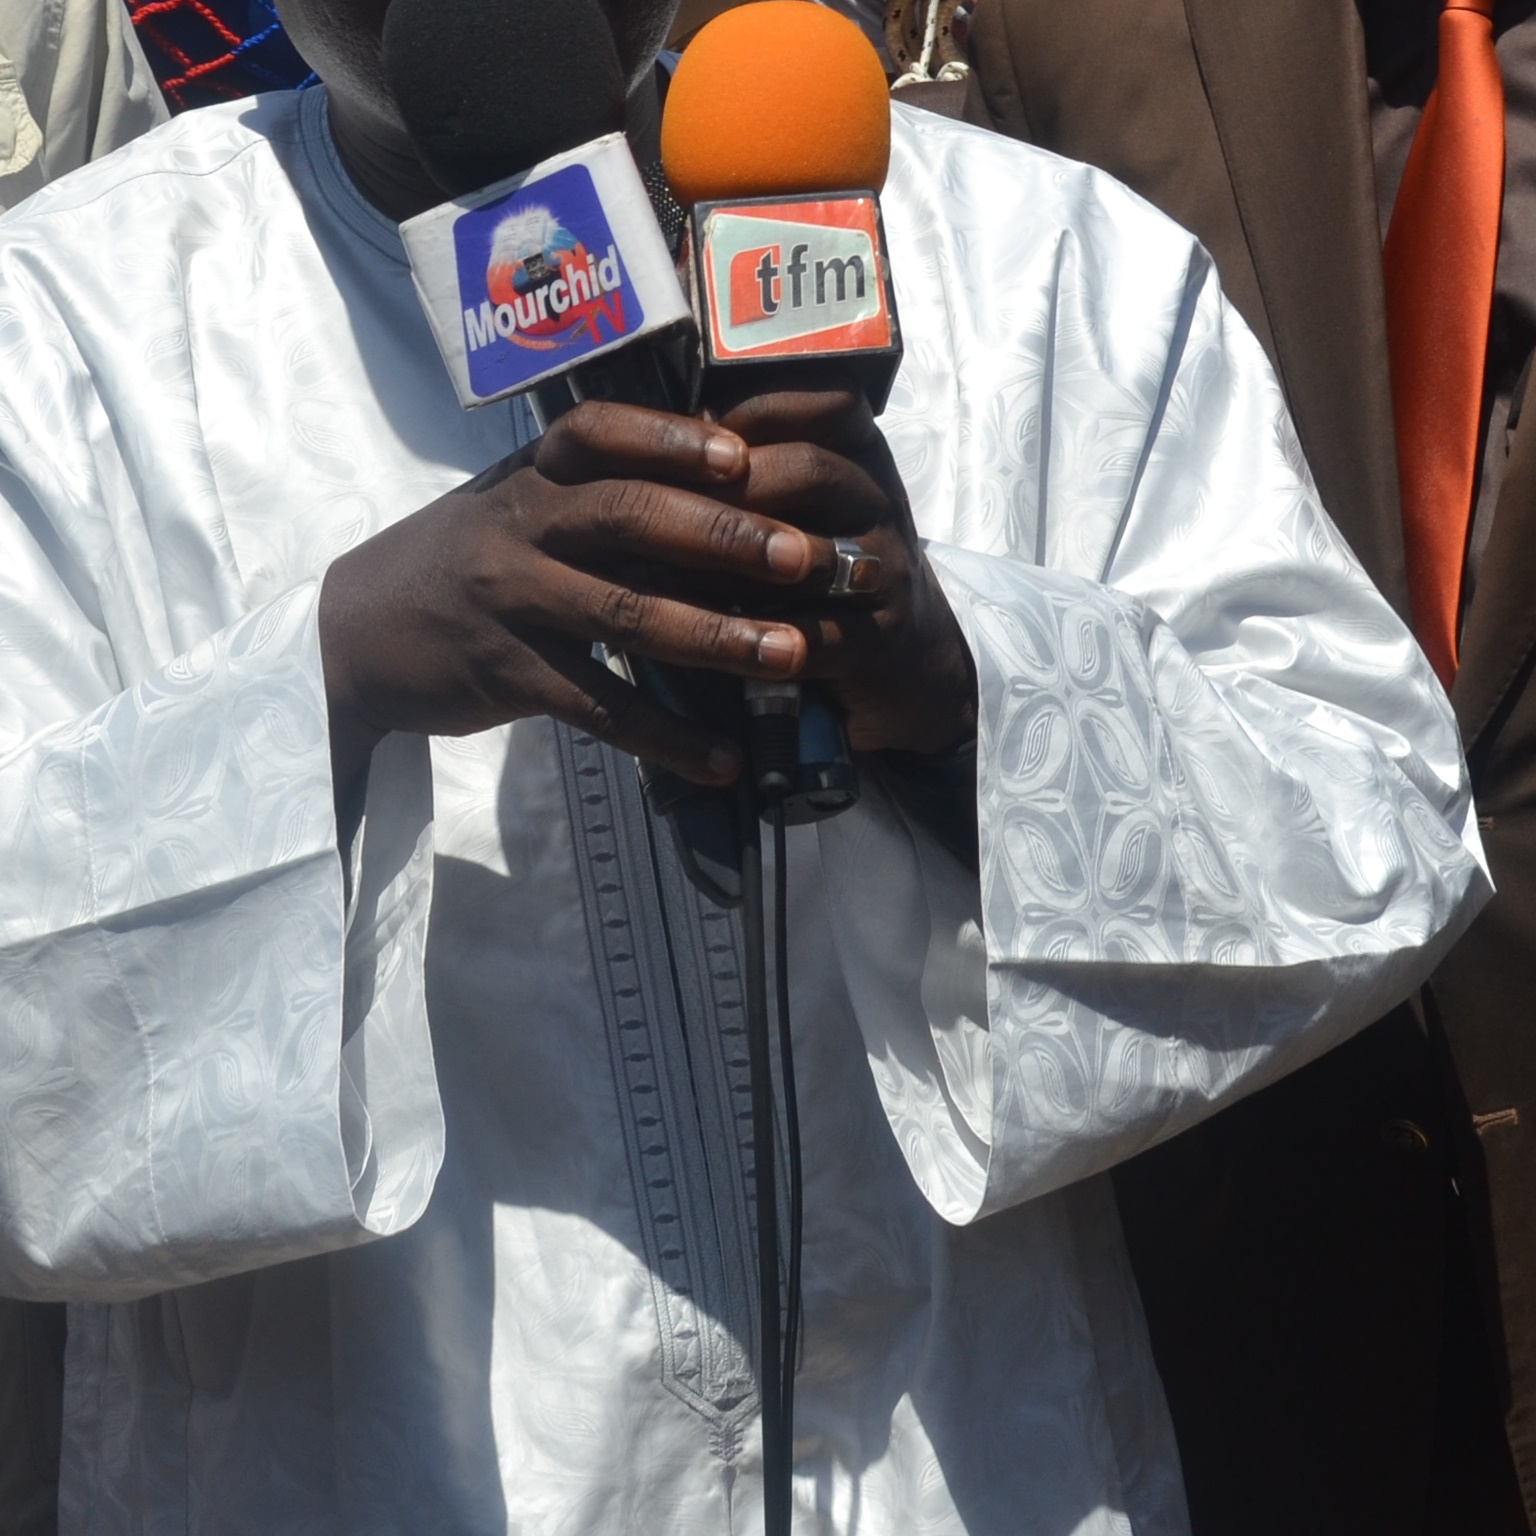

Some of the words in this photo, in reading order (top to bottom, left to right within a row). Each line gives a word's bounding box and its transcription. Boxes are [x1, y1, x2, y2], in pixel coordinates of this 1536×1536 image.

[464, 244, 621, 352] Mourchid
[755, 243, 866, 315] tfm
[582, 290, 626, 344] TV
